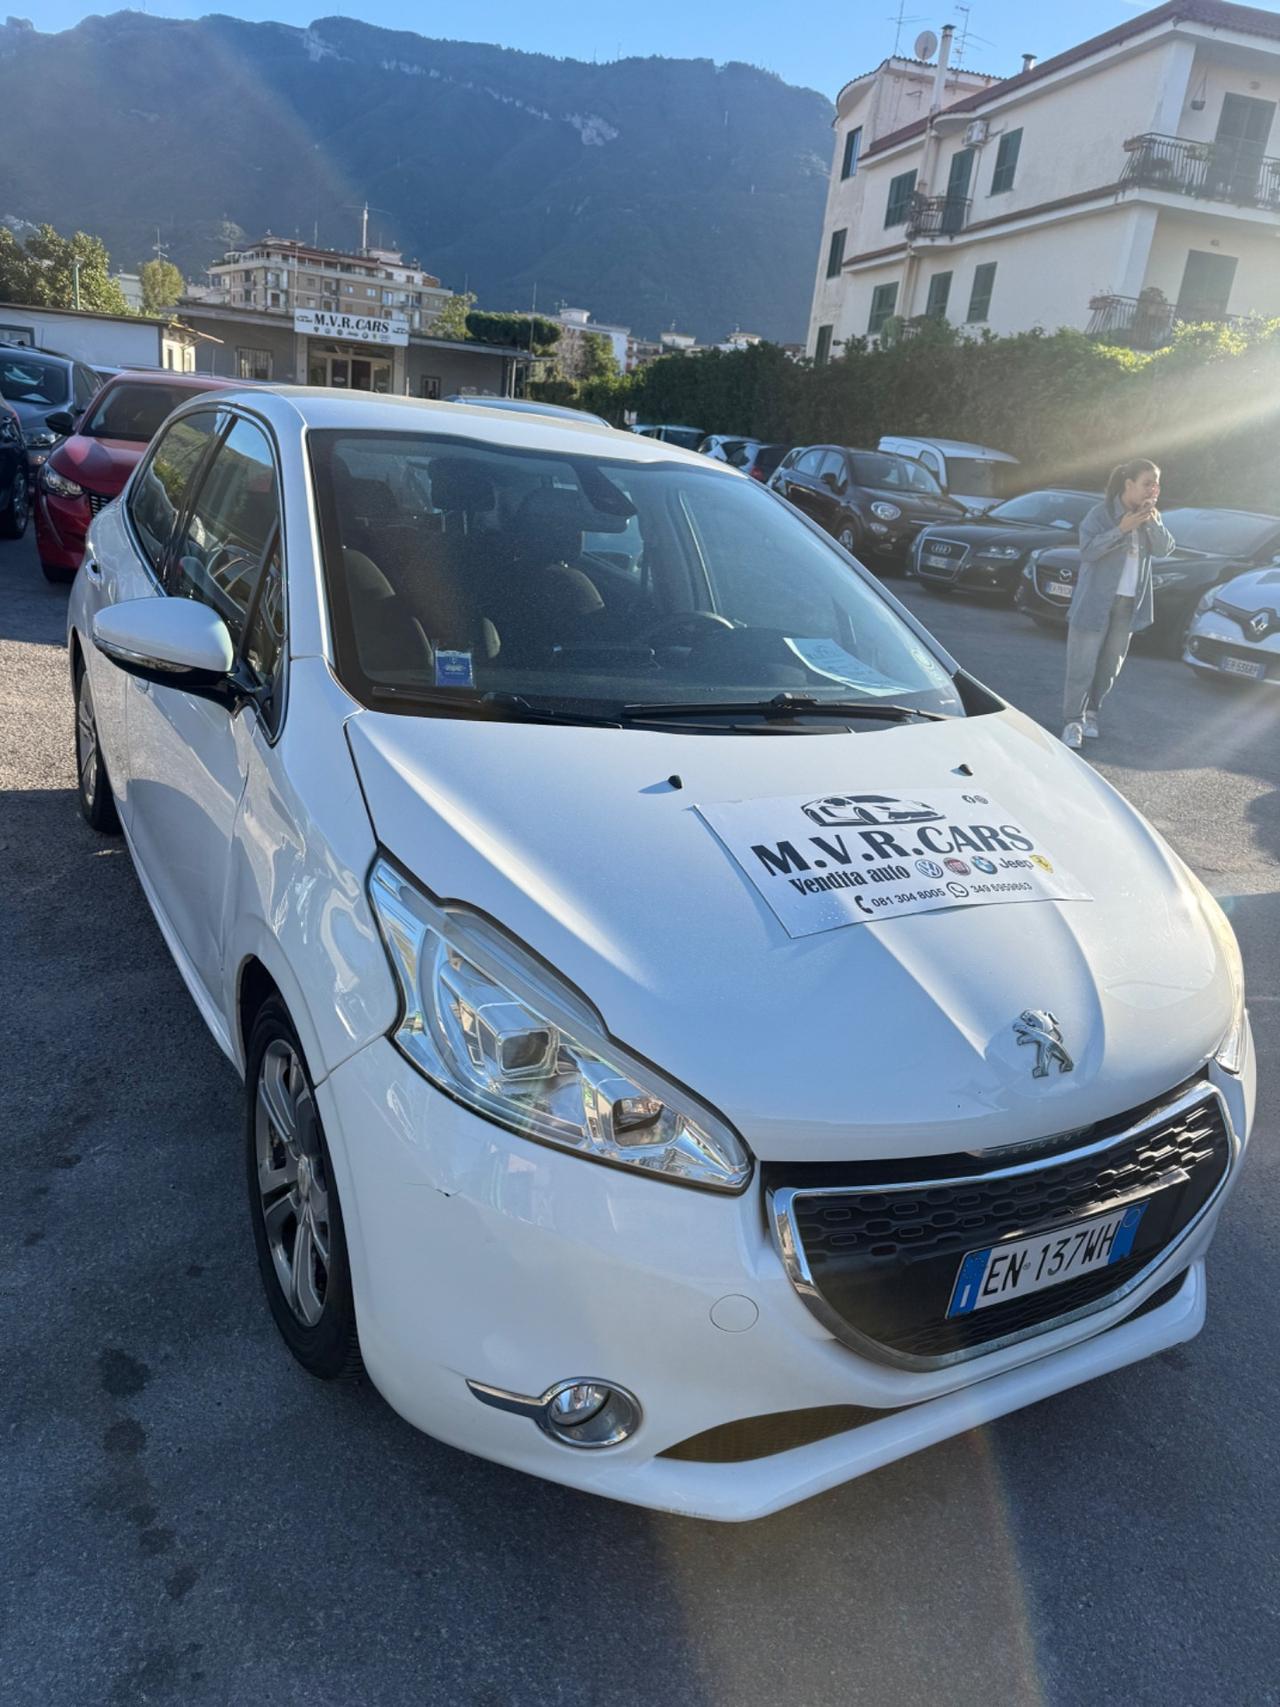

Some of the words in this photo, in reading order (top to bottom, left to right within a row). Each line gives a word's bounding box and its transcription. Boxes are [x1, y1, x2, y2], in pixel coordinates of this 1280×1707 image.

[999, 857, 1034, 871] Jeep
[788, 870, 869, 896] Vendita
[866, 864, 911, 883] auto
[870, 896, 894, 907] 081
[894, 892, 918, 903] 304
[917, 888, 946, 899] 8005
